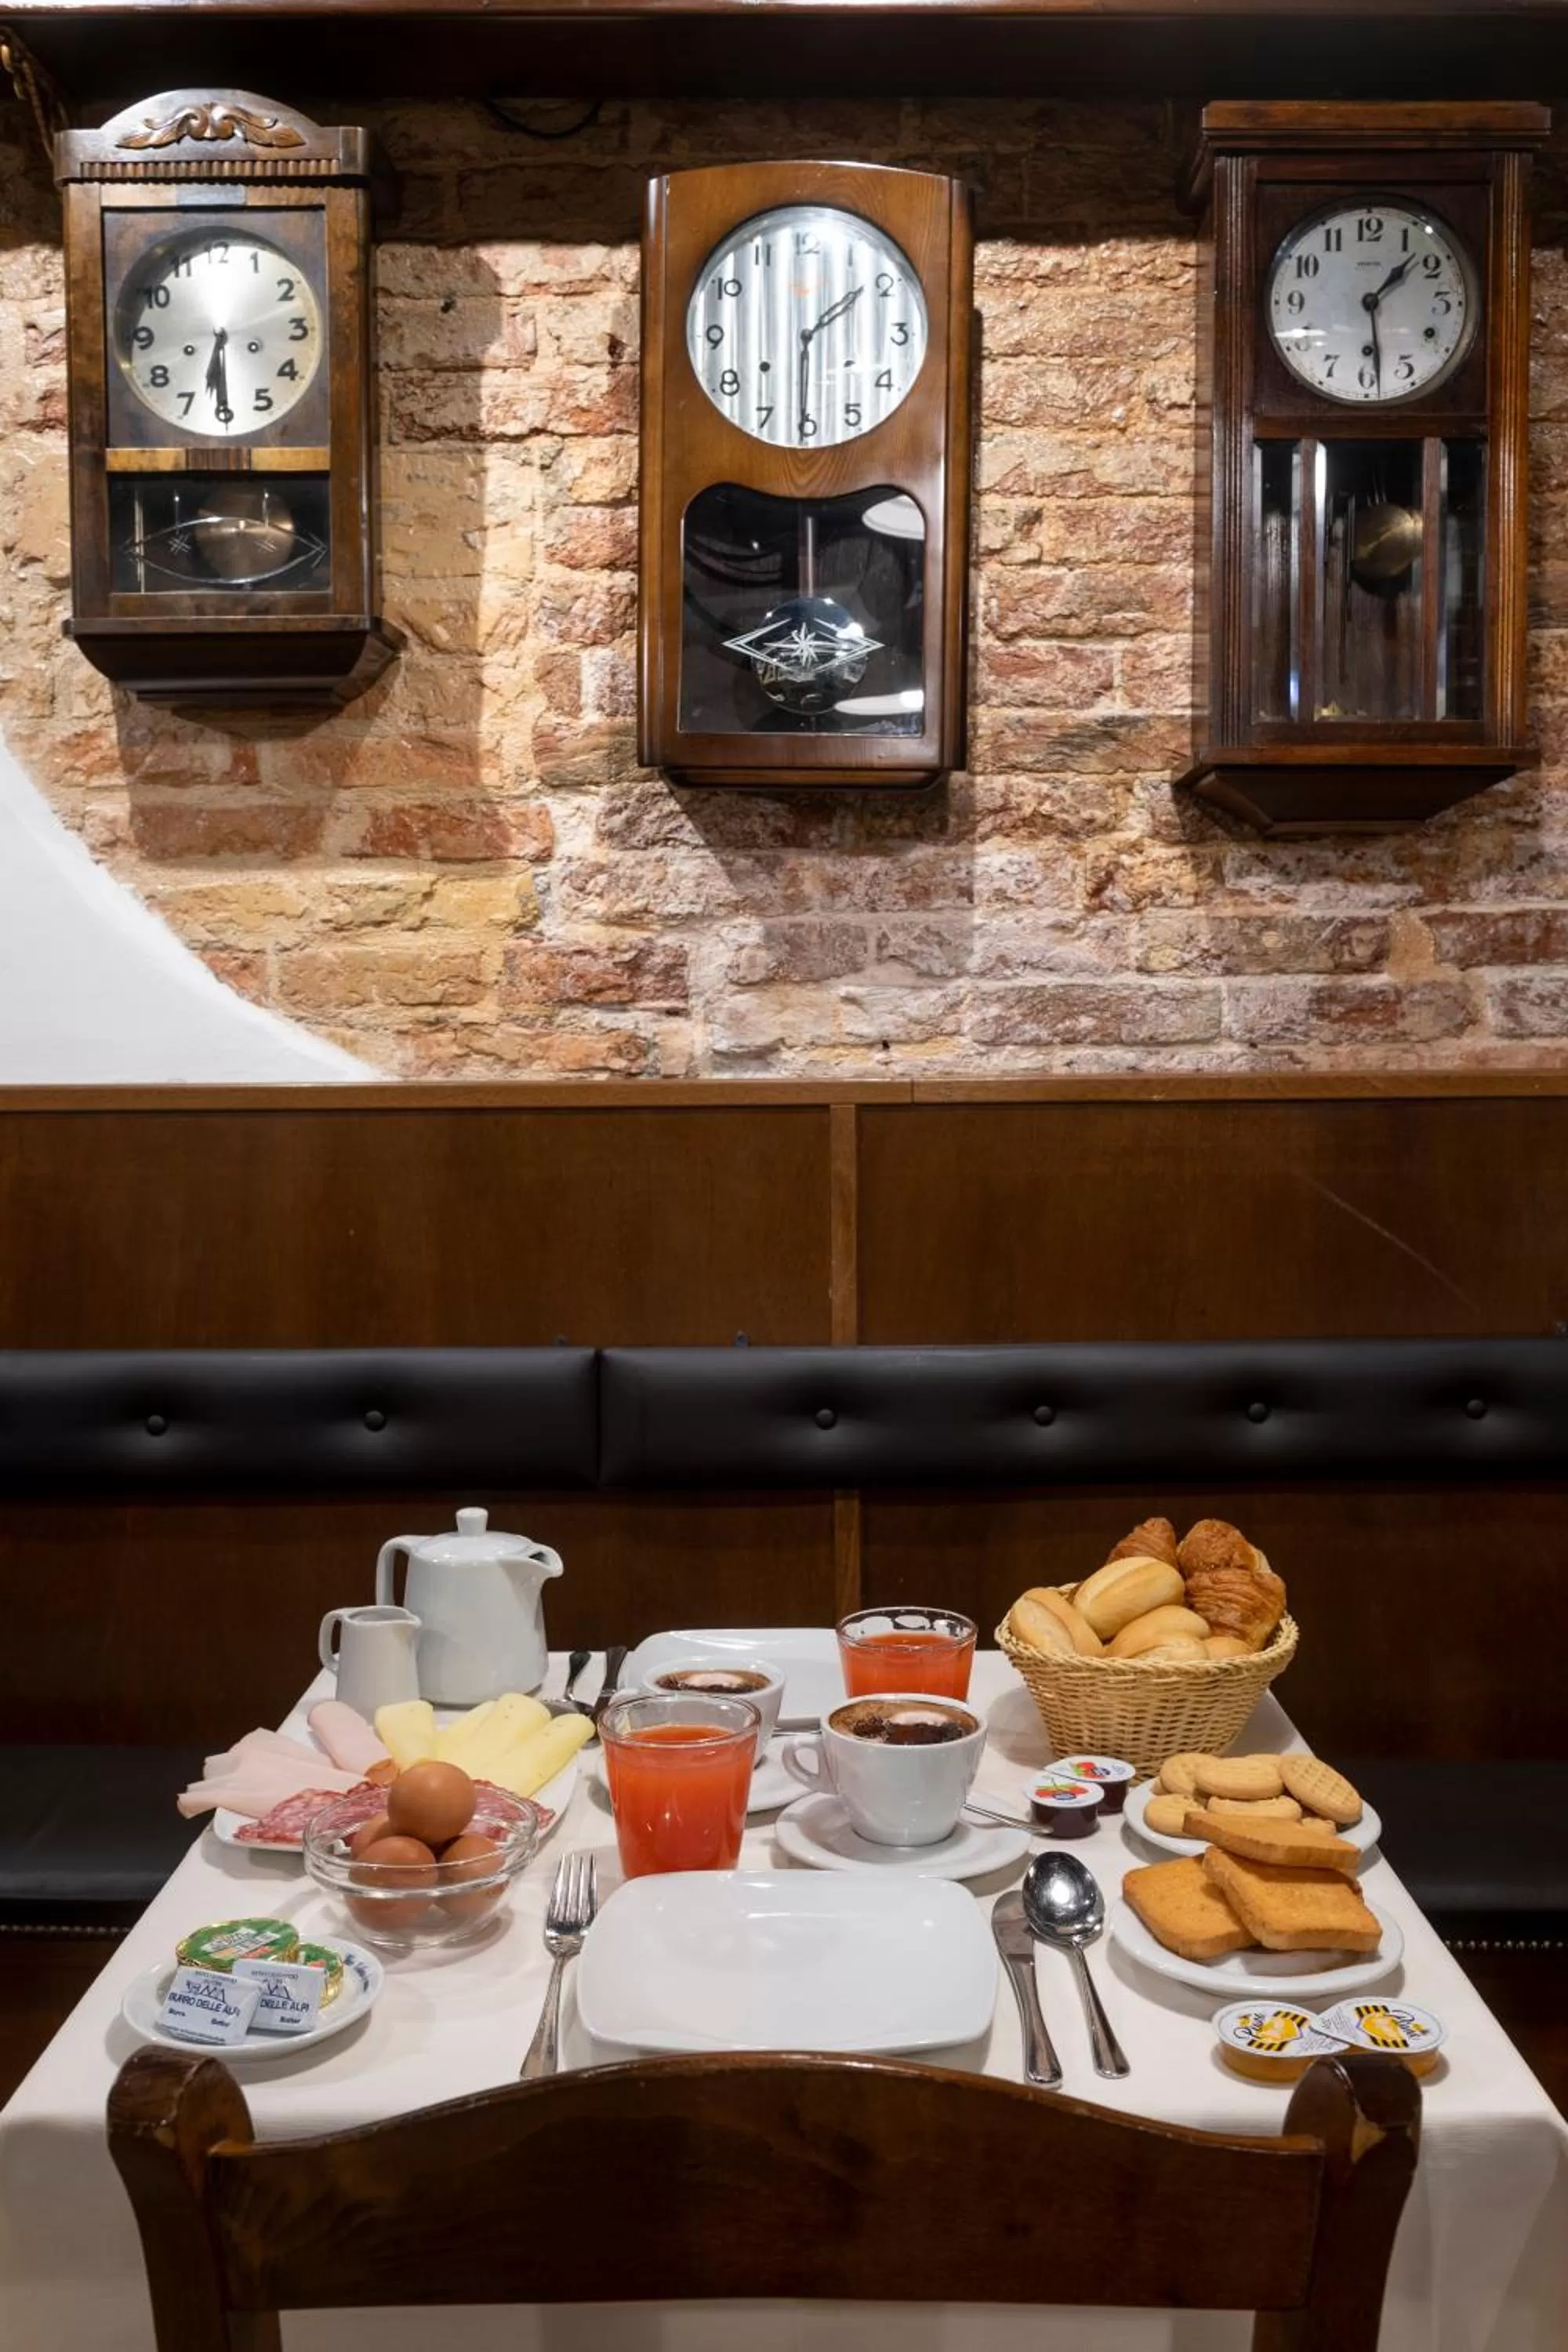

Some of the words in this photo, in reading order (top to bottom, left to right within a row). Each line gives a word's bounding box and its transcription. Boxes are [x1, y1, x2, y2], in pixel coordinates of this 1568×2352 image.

[1324, 227, 1342, 252] 11
[1356, 216, 1384, 242] 12
[1401, 227, 1410, 252] 1
[755, 244, 771, 267] 11
[797, 232, 820, 256] 12
[848, 244, 854, 267] 1
[169, 254, 193, 278] 11
[249, 251, 260, 274] 1
[1296, 253, 1319, 279] 10
[1422, 253, 1442, 279] 2
[141, 285, 170, 309] 10
[277, 278, 296, 302] 2
[717, 277, 742, 299] 10
[877, 273, 895, 297] 2
[1287, 290, 1305, 315] 9
[1432, 291, 1452, 315] 3
[132, 326, 154, 350] 9
[289, 318, 308, 341] 3
[706, 324, 724, 350] 9
[890, 322, 909, 347] 3
[150, 365, 170, 388] 8
[277, 358, 299, 381] 4
[1323, 354, 1341, 378] 7
[1357, 364, 1375, 389] 6
[1394, 354, 1415, 380] 5
[720, 368, 740, 396] 8
[874, 368, 894, 392] 4
[176, 392, 196, 416] 7
[253, 388, 274, 412] 5
[756, 406, 774, 429] 7
[798, 413, 818, 437] 6
[844, 403, 862, 426] 5
[196, 1999, 223, 2013] DELLE
[260, 1998, 289, 2009] DELLE
[289, 2001, 310, 2013] ALPI
